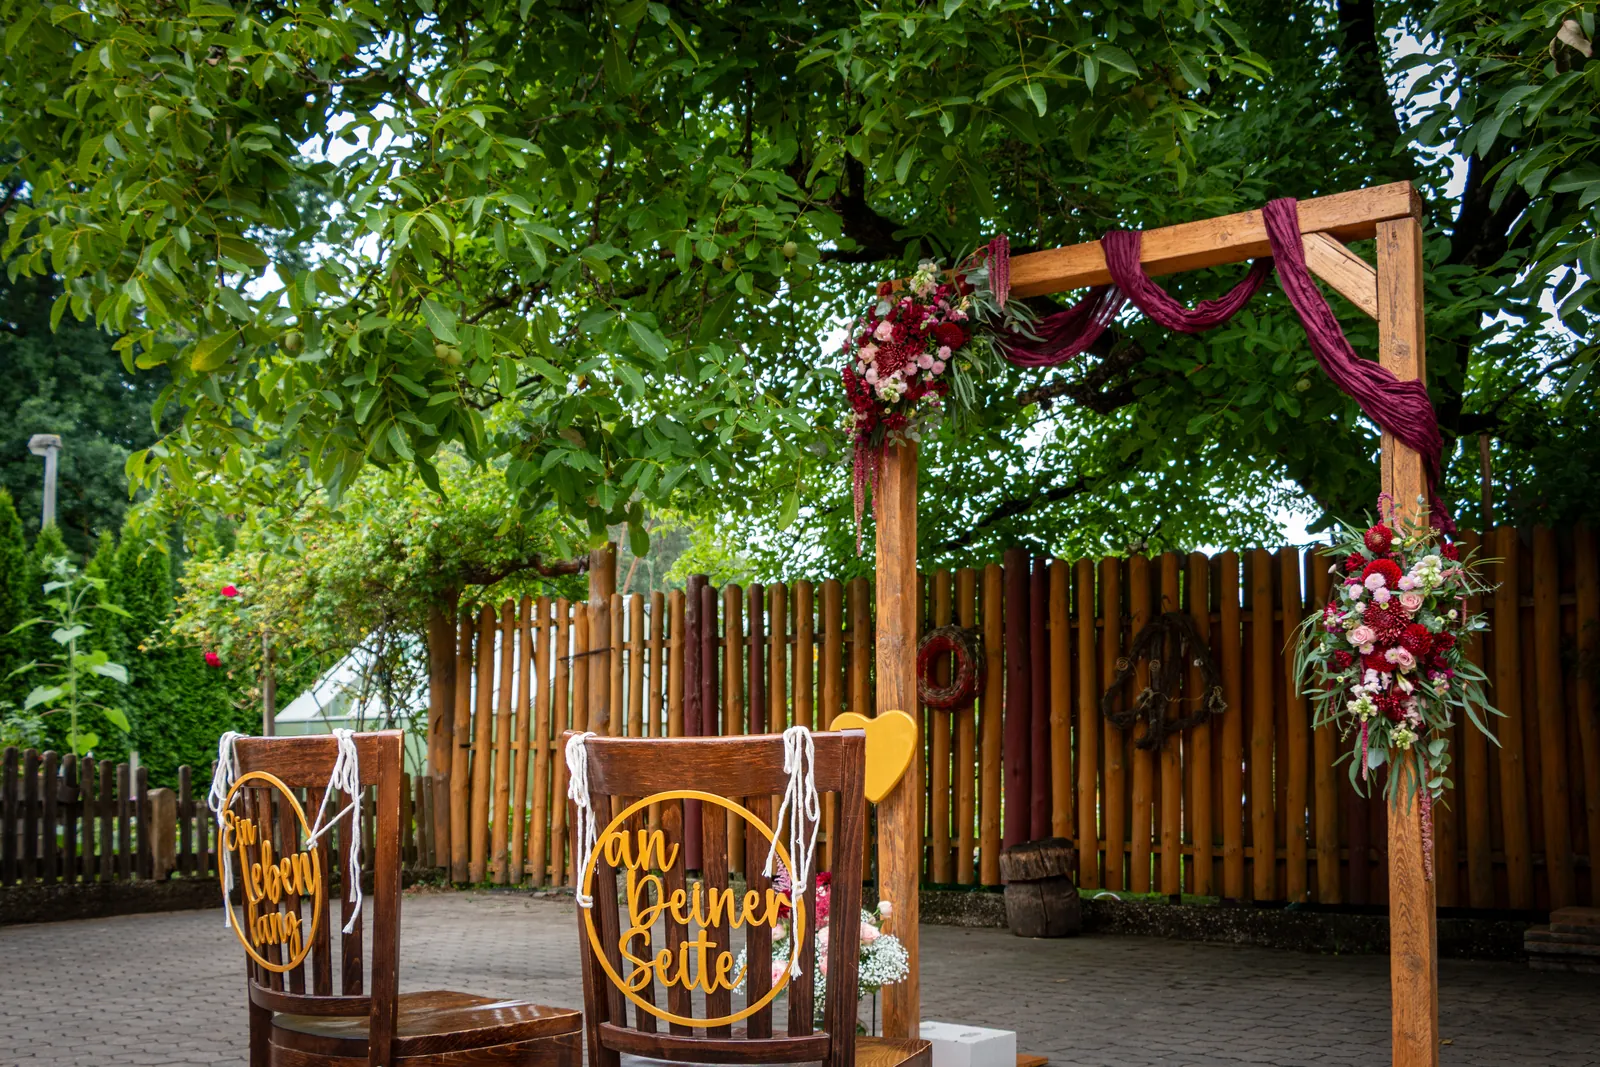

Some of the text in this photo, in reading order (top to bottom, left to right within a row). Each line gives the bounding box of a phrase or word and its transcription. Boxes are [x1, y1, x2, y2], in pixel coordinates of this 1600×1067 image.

[224, 810, 257, 850] Ein
[604, 829, 679, 872] an
[627, 869, 794, 930] Deiner
[249, 900, 303, 961] lang
[619, 928, 747, 994] Seite
